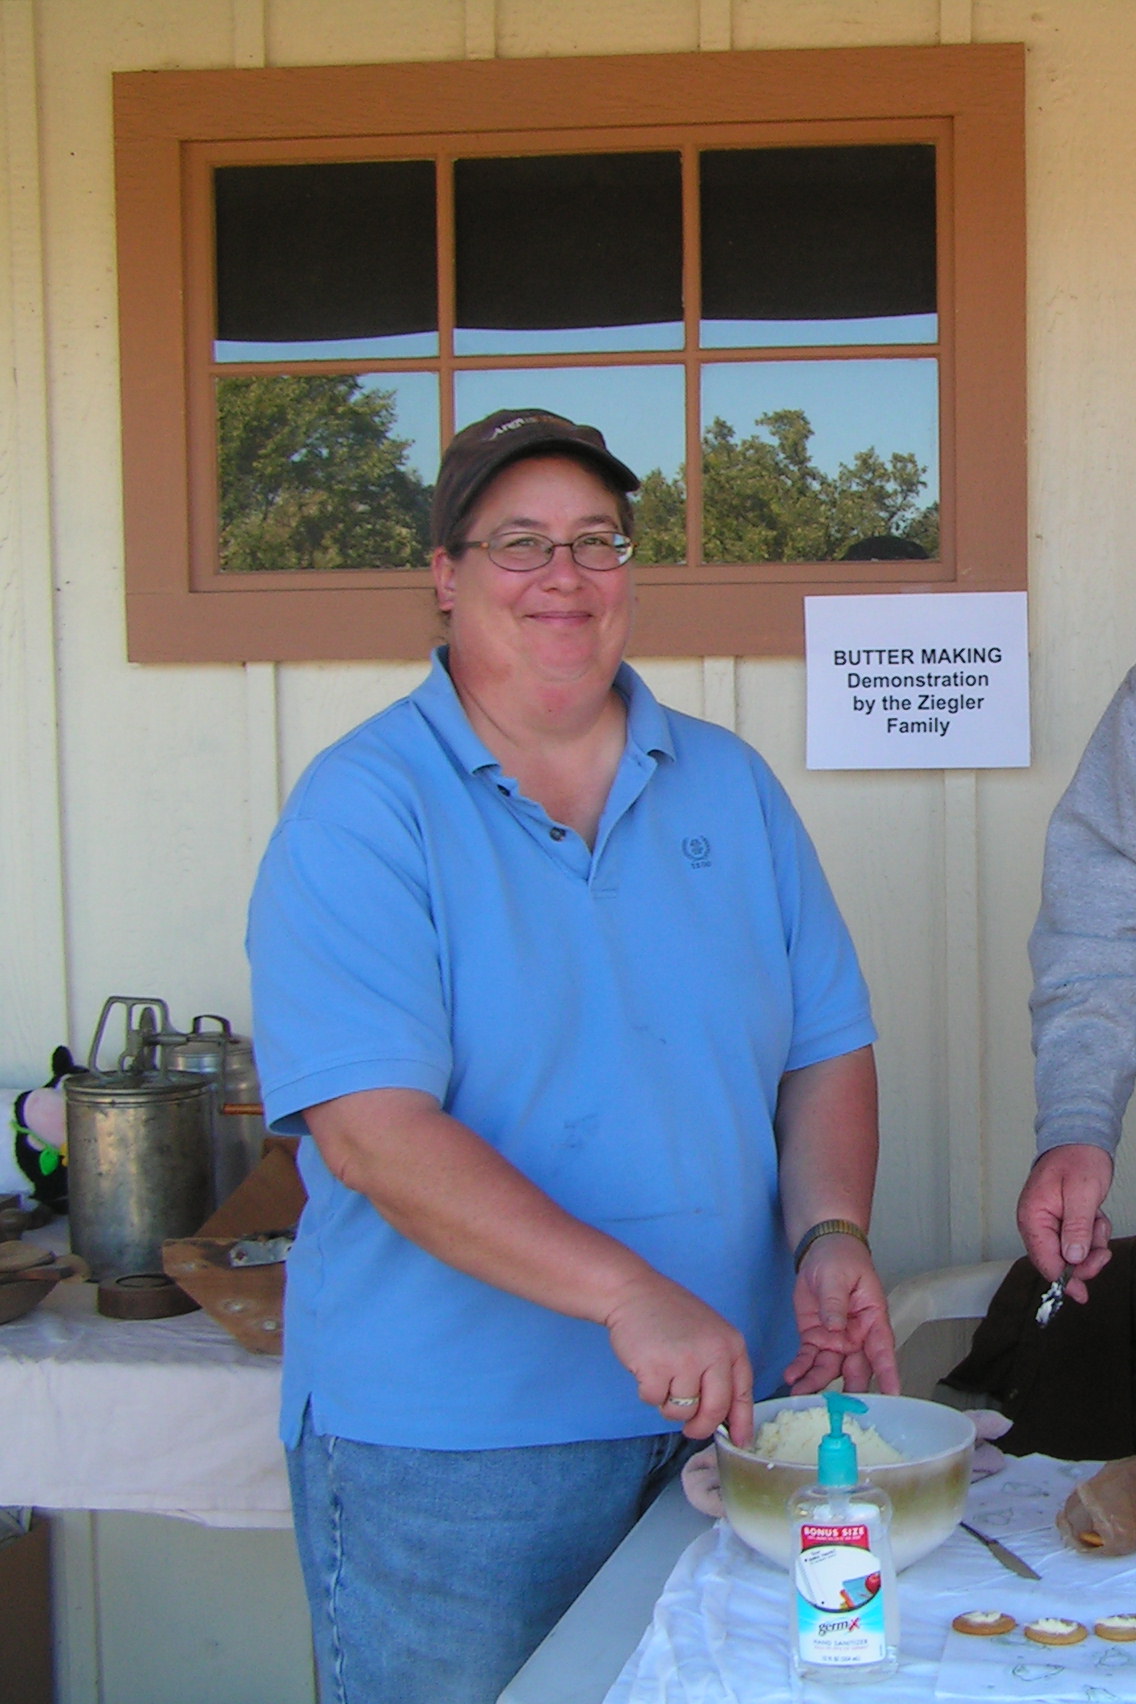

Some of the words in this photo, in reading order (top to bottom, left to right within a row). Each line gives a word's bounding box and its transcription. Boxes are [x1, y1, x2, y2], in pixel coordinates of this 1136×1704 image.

[834, 649, 914, 666] BUTTER
[921, 648, 1002, 664] MAKING
[848, 672, 989, 688] Demonstration
[853, 696, 875, 714] by
[882, 696, 912, 710] the
[918, 694, 984, 714] Ziegler
[887, 718, 950, 736] Family
[804, 1526, 838, 1536] BONUS
[841, 1526, 864, 1536] SIZE
